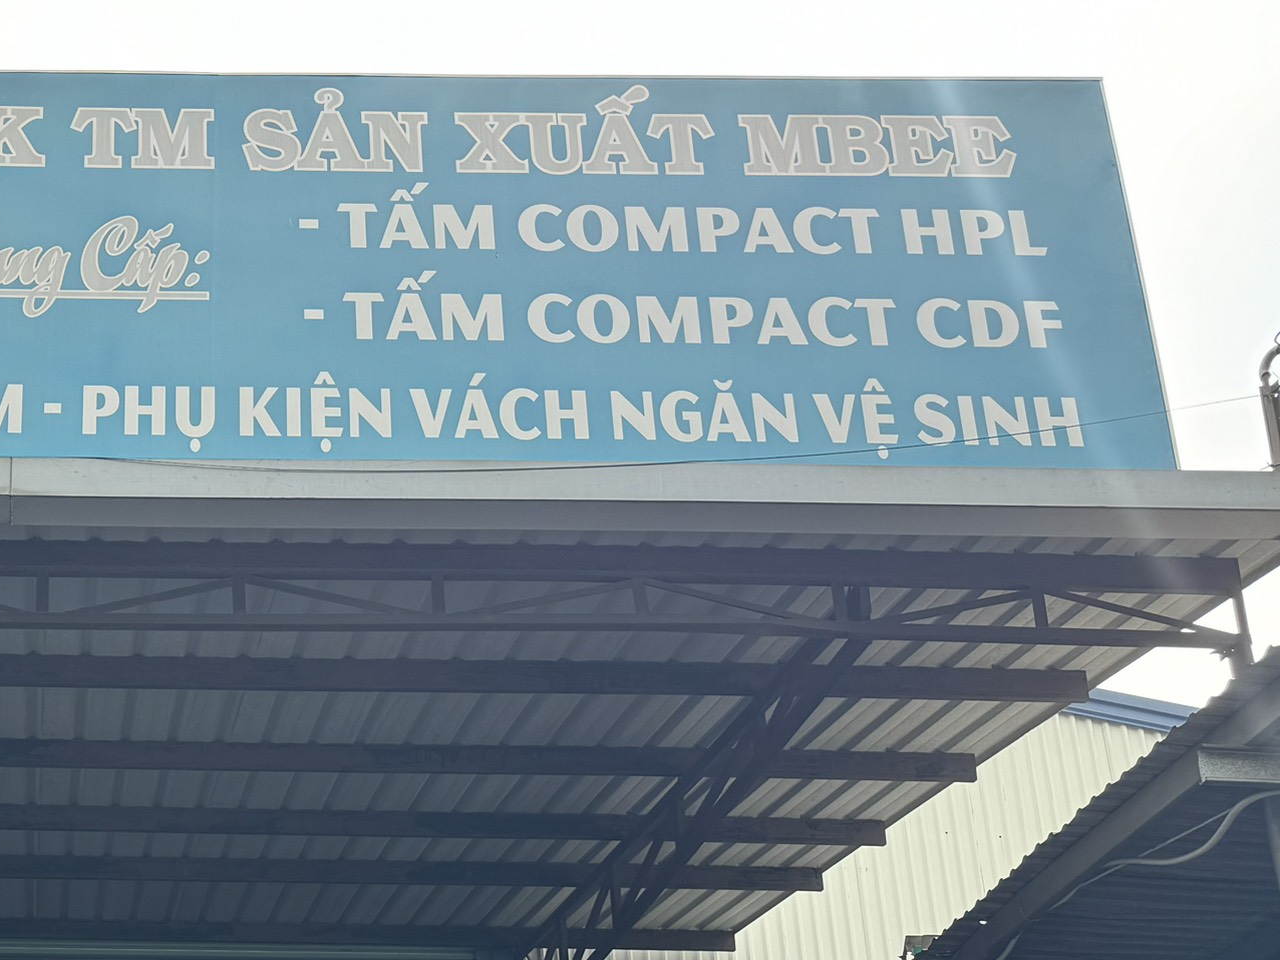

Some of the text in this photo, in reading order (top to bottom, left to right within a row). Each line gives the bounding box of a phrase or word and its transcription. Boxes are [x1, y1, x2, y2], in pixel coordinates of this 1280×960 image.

[71, 107, 216, 171] TM
[242, 87, 428, 173] SẢN
[454, 84, 715, 176] XUẤT
[737, 113, 1018, 178] MBEE
[337, 182, 496, 250] TẤM
[518, 203, 880, 255] COMPACT
[901, 208, 1048, 257] HPL
[80, 215, 212, 314] Cấp:
[342, 270, 505, 342] TẤM
[526, 292, 897, 348] COMPACT
[916, 297, 1064, 350] CDF
[81, 384, 217, 453] PHỤ
[238, 371, 393, 454] KIỆN
[409, 372, 590, 441] VÁCH
[609, 378, 800, 444] NGĂN
[811, 378, 901, 460] VỆ
[914, 393, 1086, 449] SINH
